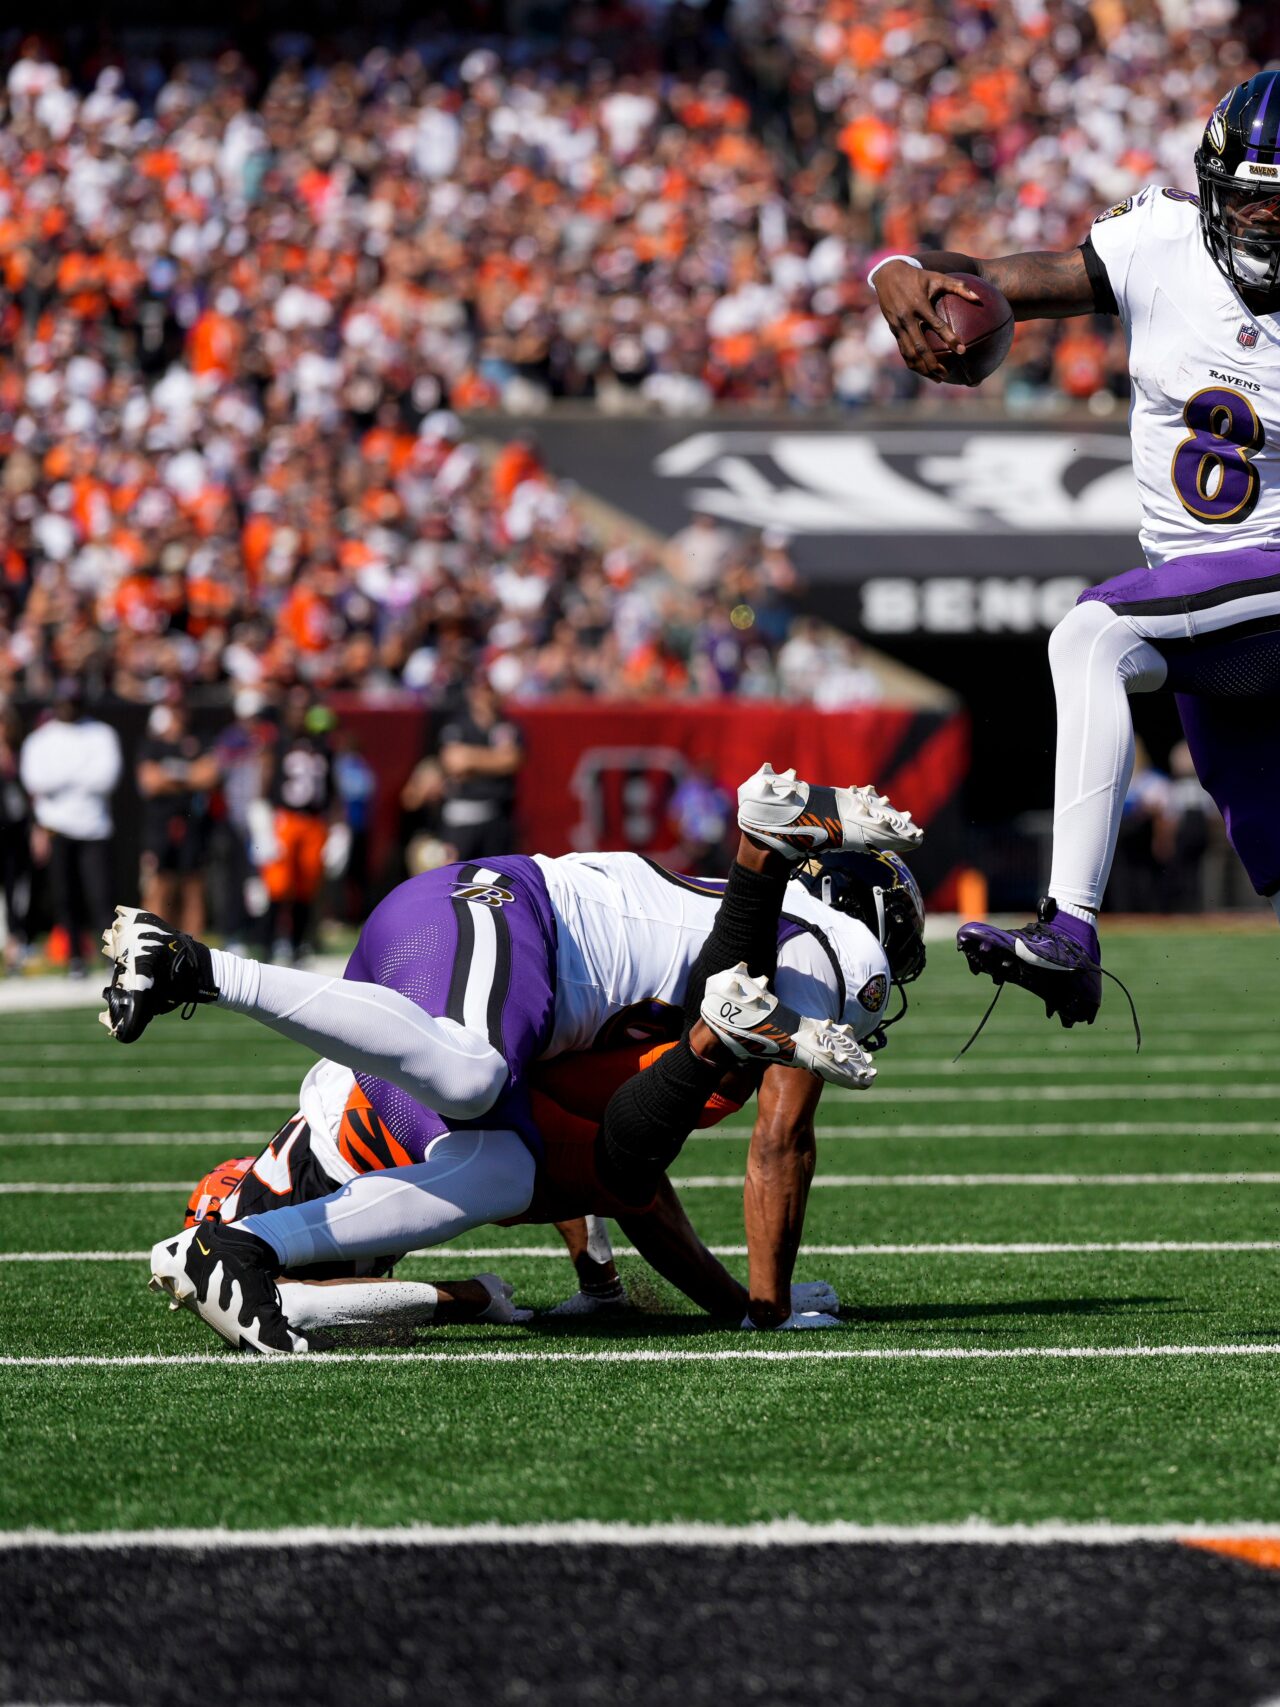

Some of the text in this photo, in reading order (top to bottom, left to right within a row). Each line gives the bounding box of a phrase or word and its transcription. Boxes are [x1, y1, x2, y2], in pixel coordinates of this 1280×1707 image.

[1249, 165, 1278, 178] RAVENS
[1208, 369, 1261, 391] RAVENS
[1171, 386, 1265, 524] 8
[720, 1001, 743, 1025] 20
